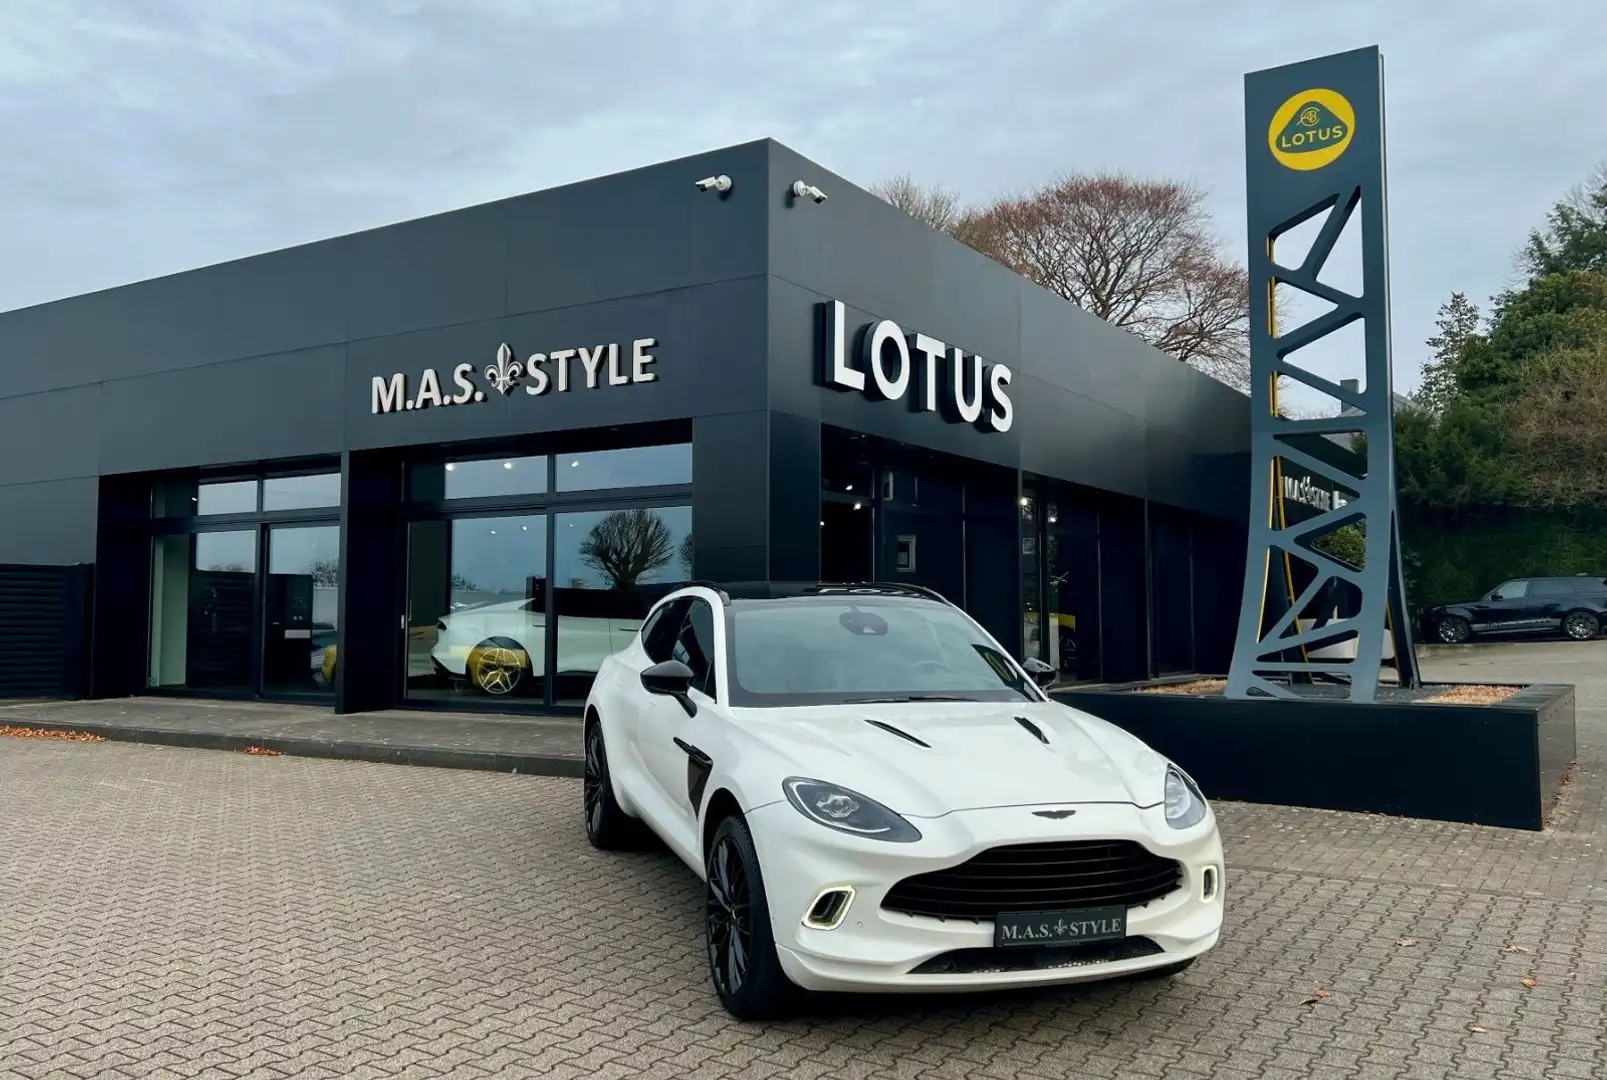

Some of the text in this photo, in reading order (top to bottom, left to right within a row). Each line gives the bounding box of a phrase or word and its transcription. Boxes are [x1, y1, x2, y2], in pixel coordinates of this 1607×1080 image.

[1281, 125, 1343, 147] LOTUS
[371, 337, 657, 414] M.A.S. STYLE
[830, 299, 1013, 432] LOTUS
[1001, 918, 1122, 940] M.A.S. STYLE
